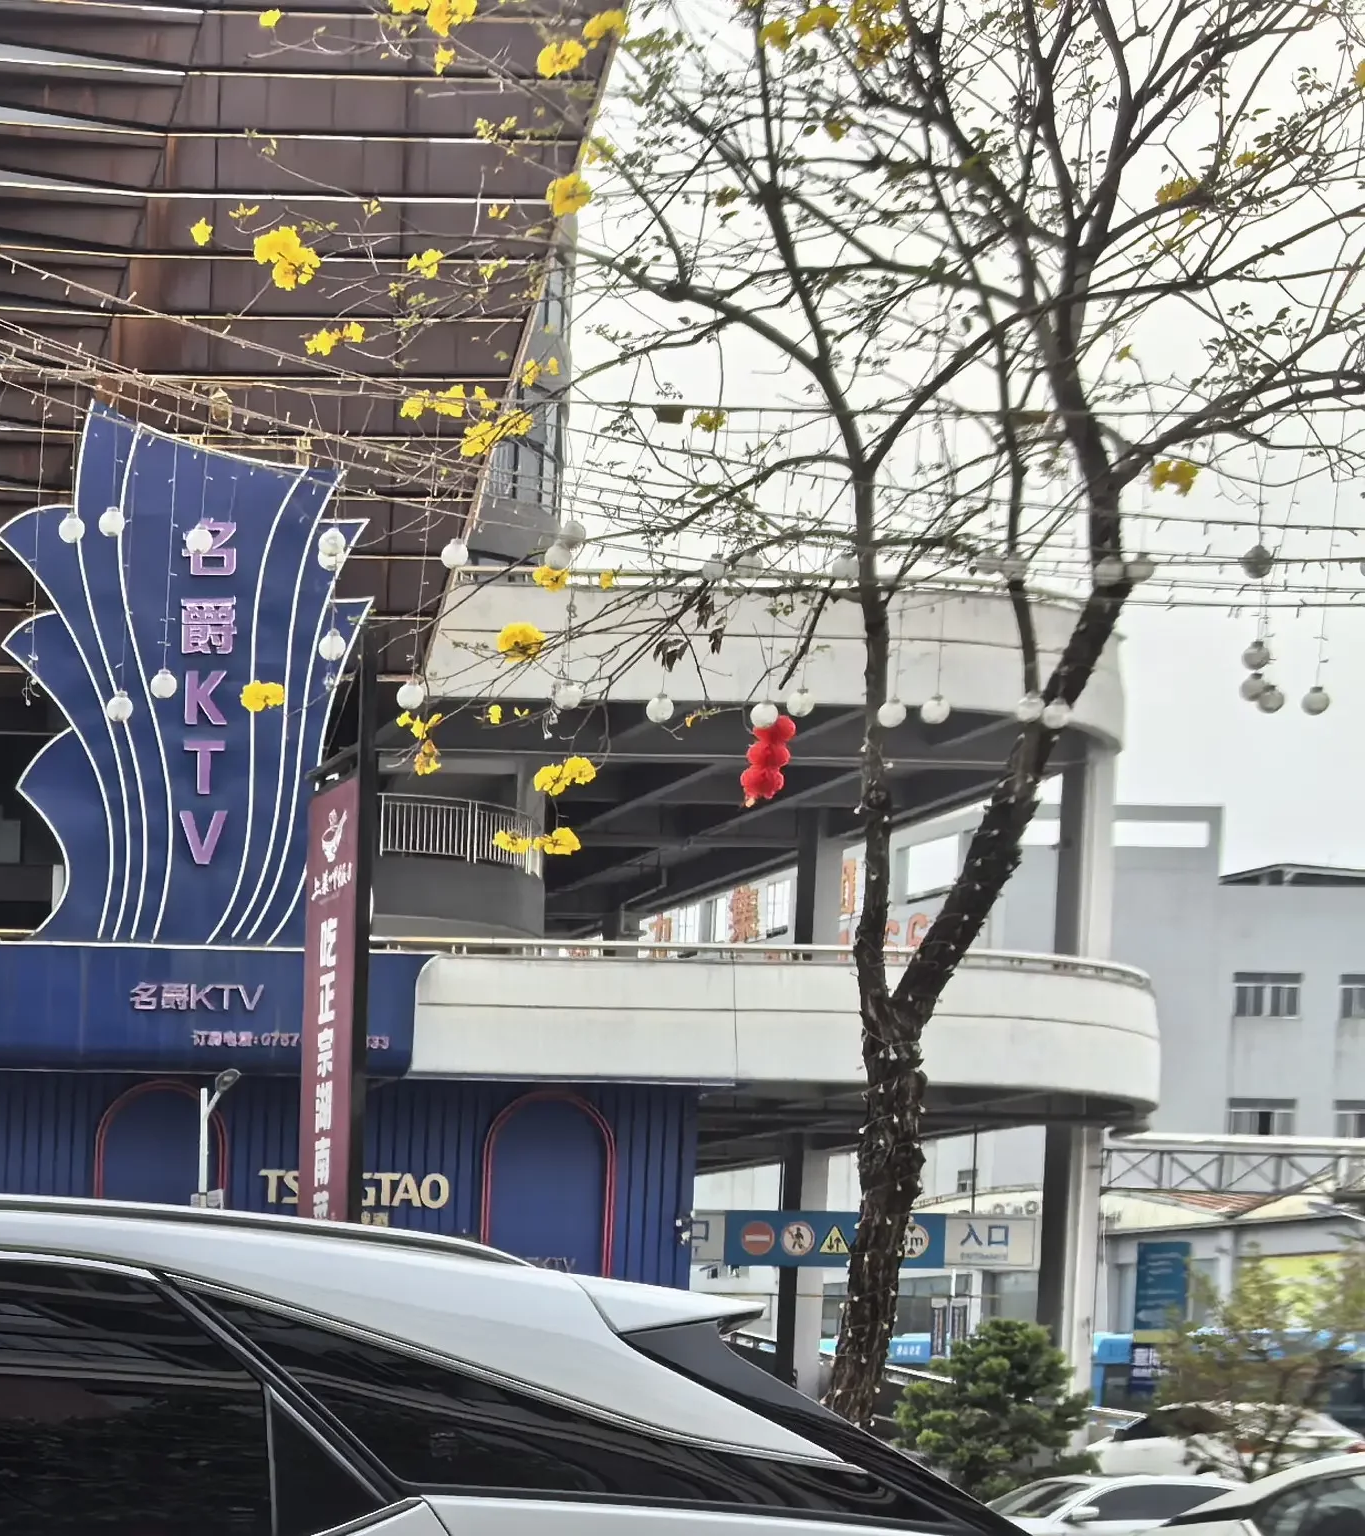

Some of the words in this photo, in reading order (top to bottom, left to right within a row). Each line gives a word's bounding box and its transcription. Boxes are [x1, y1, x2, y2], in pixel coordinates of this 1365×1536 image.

[180, 517, 238, 866] 名爵KTV
[129, 981, 265, 1012] 名爵KTV
[960, 1222, 1010, 1247] 入口
